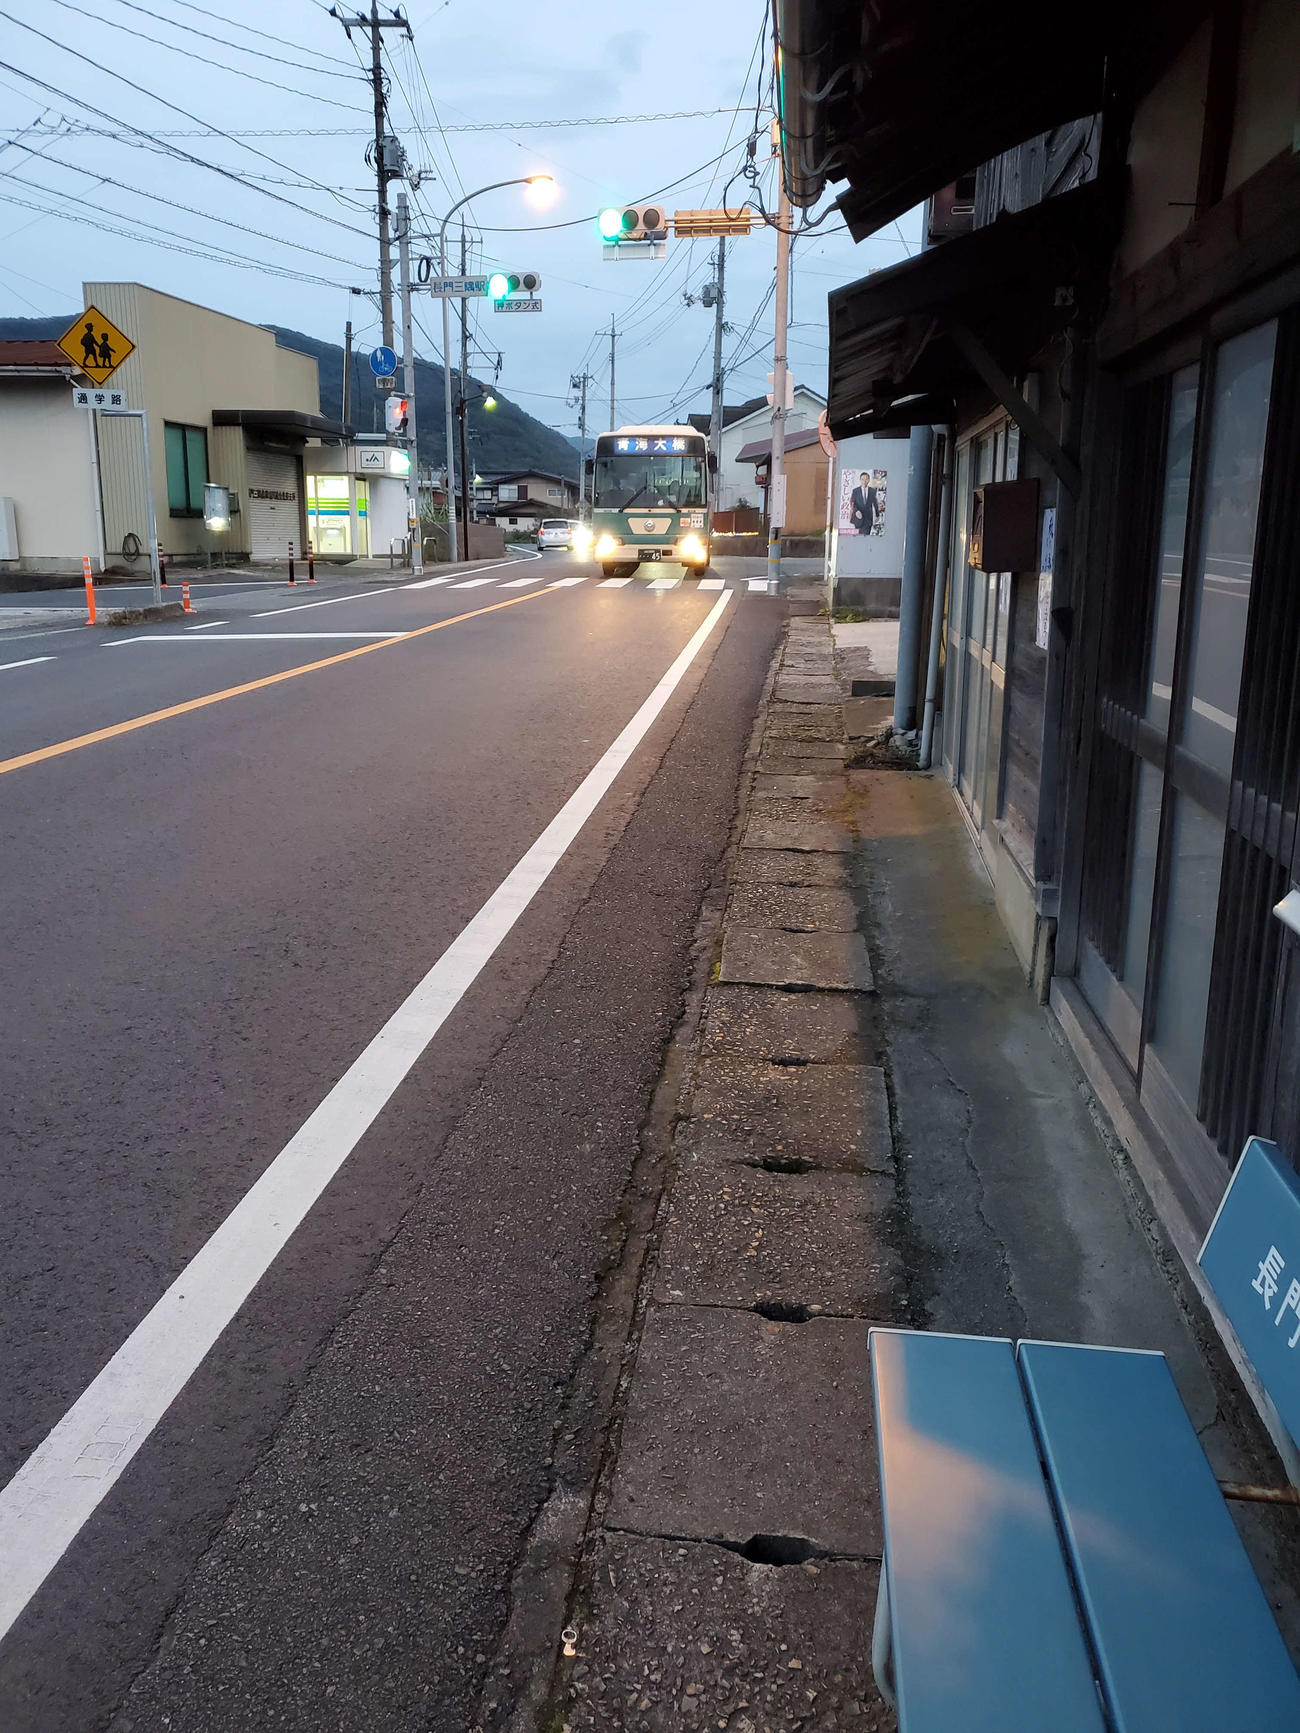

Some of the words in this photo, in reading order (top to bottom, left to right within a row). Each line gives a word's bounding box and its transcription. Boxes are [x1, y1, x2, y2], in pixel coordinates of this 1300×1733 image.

[433, 280, 486, 293] 長門三隅駅
[77, 392, 121, 405] 通学路
[617, 437, 685, 451] 青海大橋
